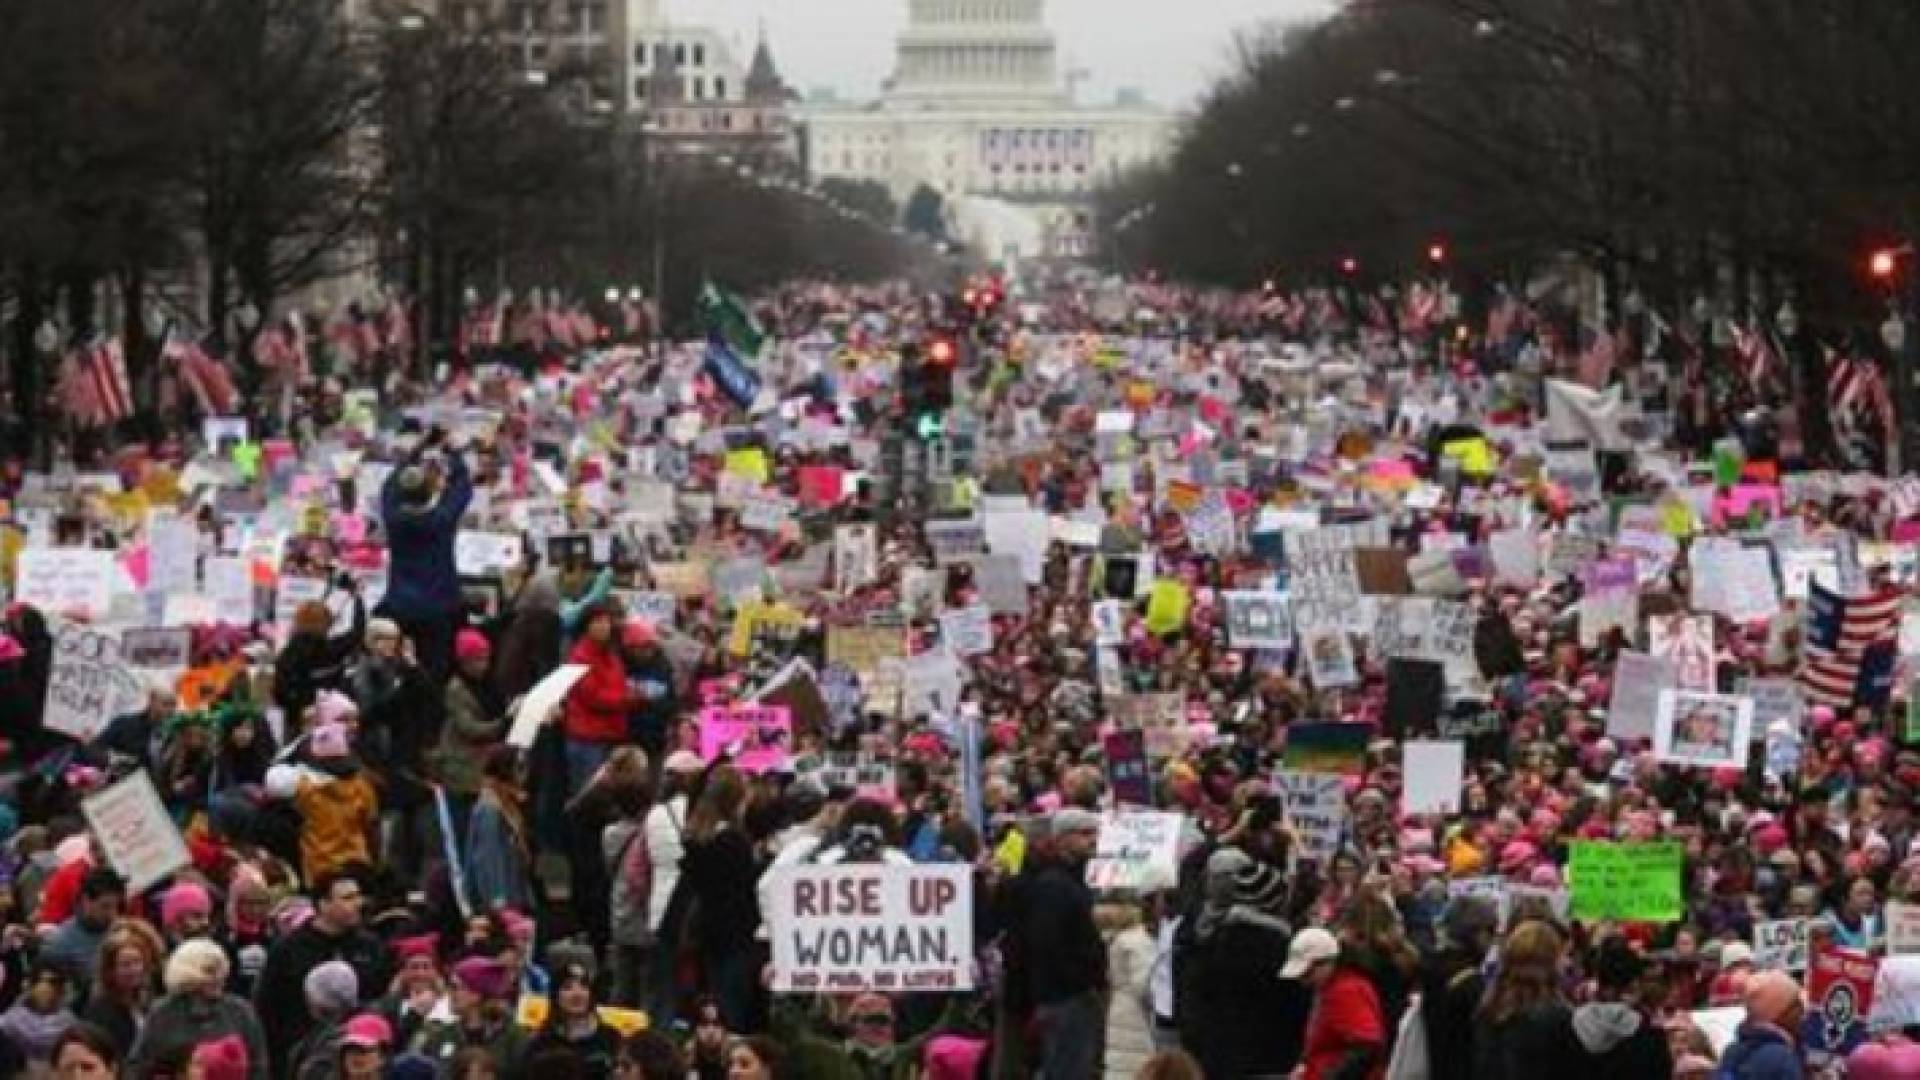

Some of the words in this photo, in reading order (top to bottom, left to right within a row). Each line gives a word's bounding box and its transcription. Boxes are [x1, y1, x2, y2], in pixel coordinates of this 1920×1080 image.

[795, 877, 881, 917] RISE
[910, 877, 956, 917] UP
[794, 925, 958, 965] WOMAN.
